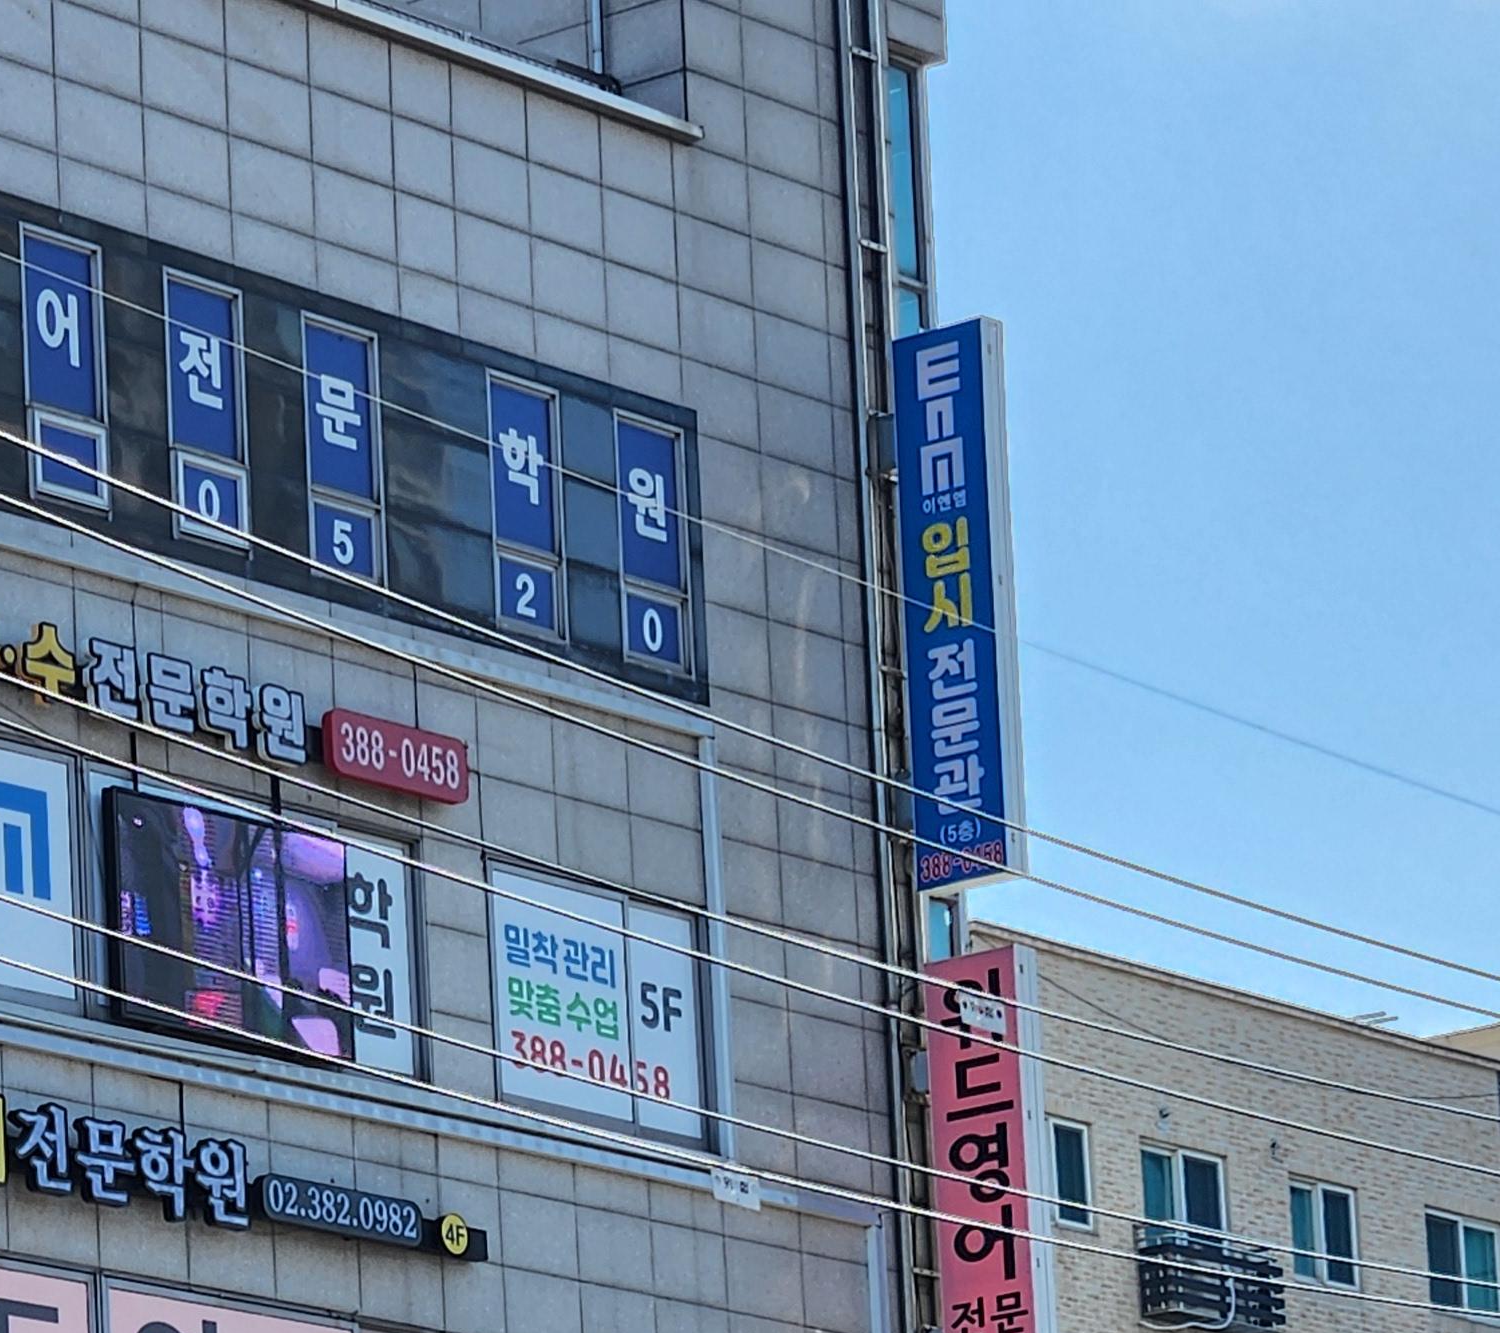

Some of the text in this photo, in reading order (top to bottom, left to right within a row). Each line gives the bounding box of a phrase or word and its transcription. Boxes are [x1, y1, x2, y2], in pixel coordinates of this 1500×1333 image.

[921, 495, 967, 515] 이엔엠
[920, 515, 974, 634] 입시
[87, 634, 308, 766] 전문학원
[338, 722, 461, 790] 388-0458
[927, 637, 983, 815] 전문관
[940, 816, 981, 845] (5층)
[639, 980, 684, 1033] 5F
[267, 1171, 419, 1242] 02.382.0982
[443, 1221, 469, 1248] 4F
